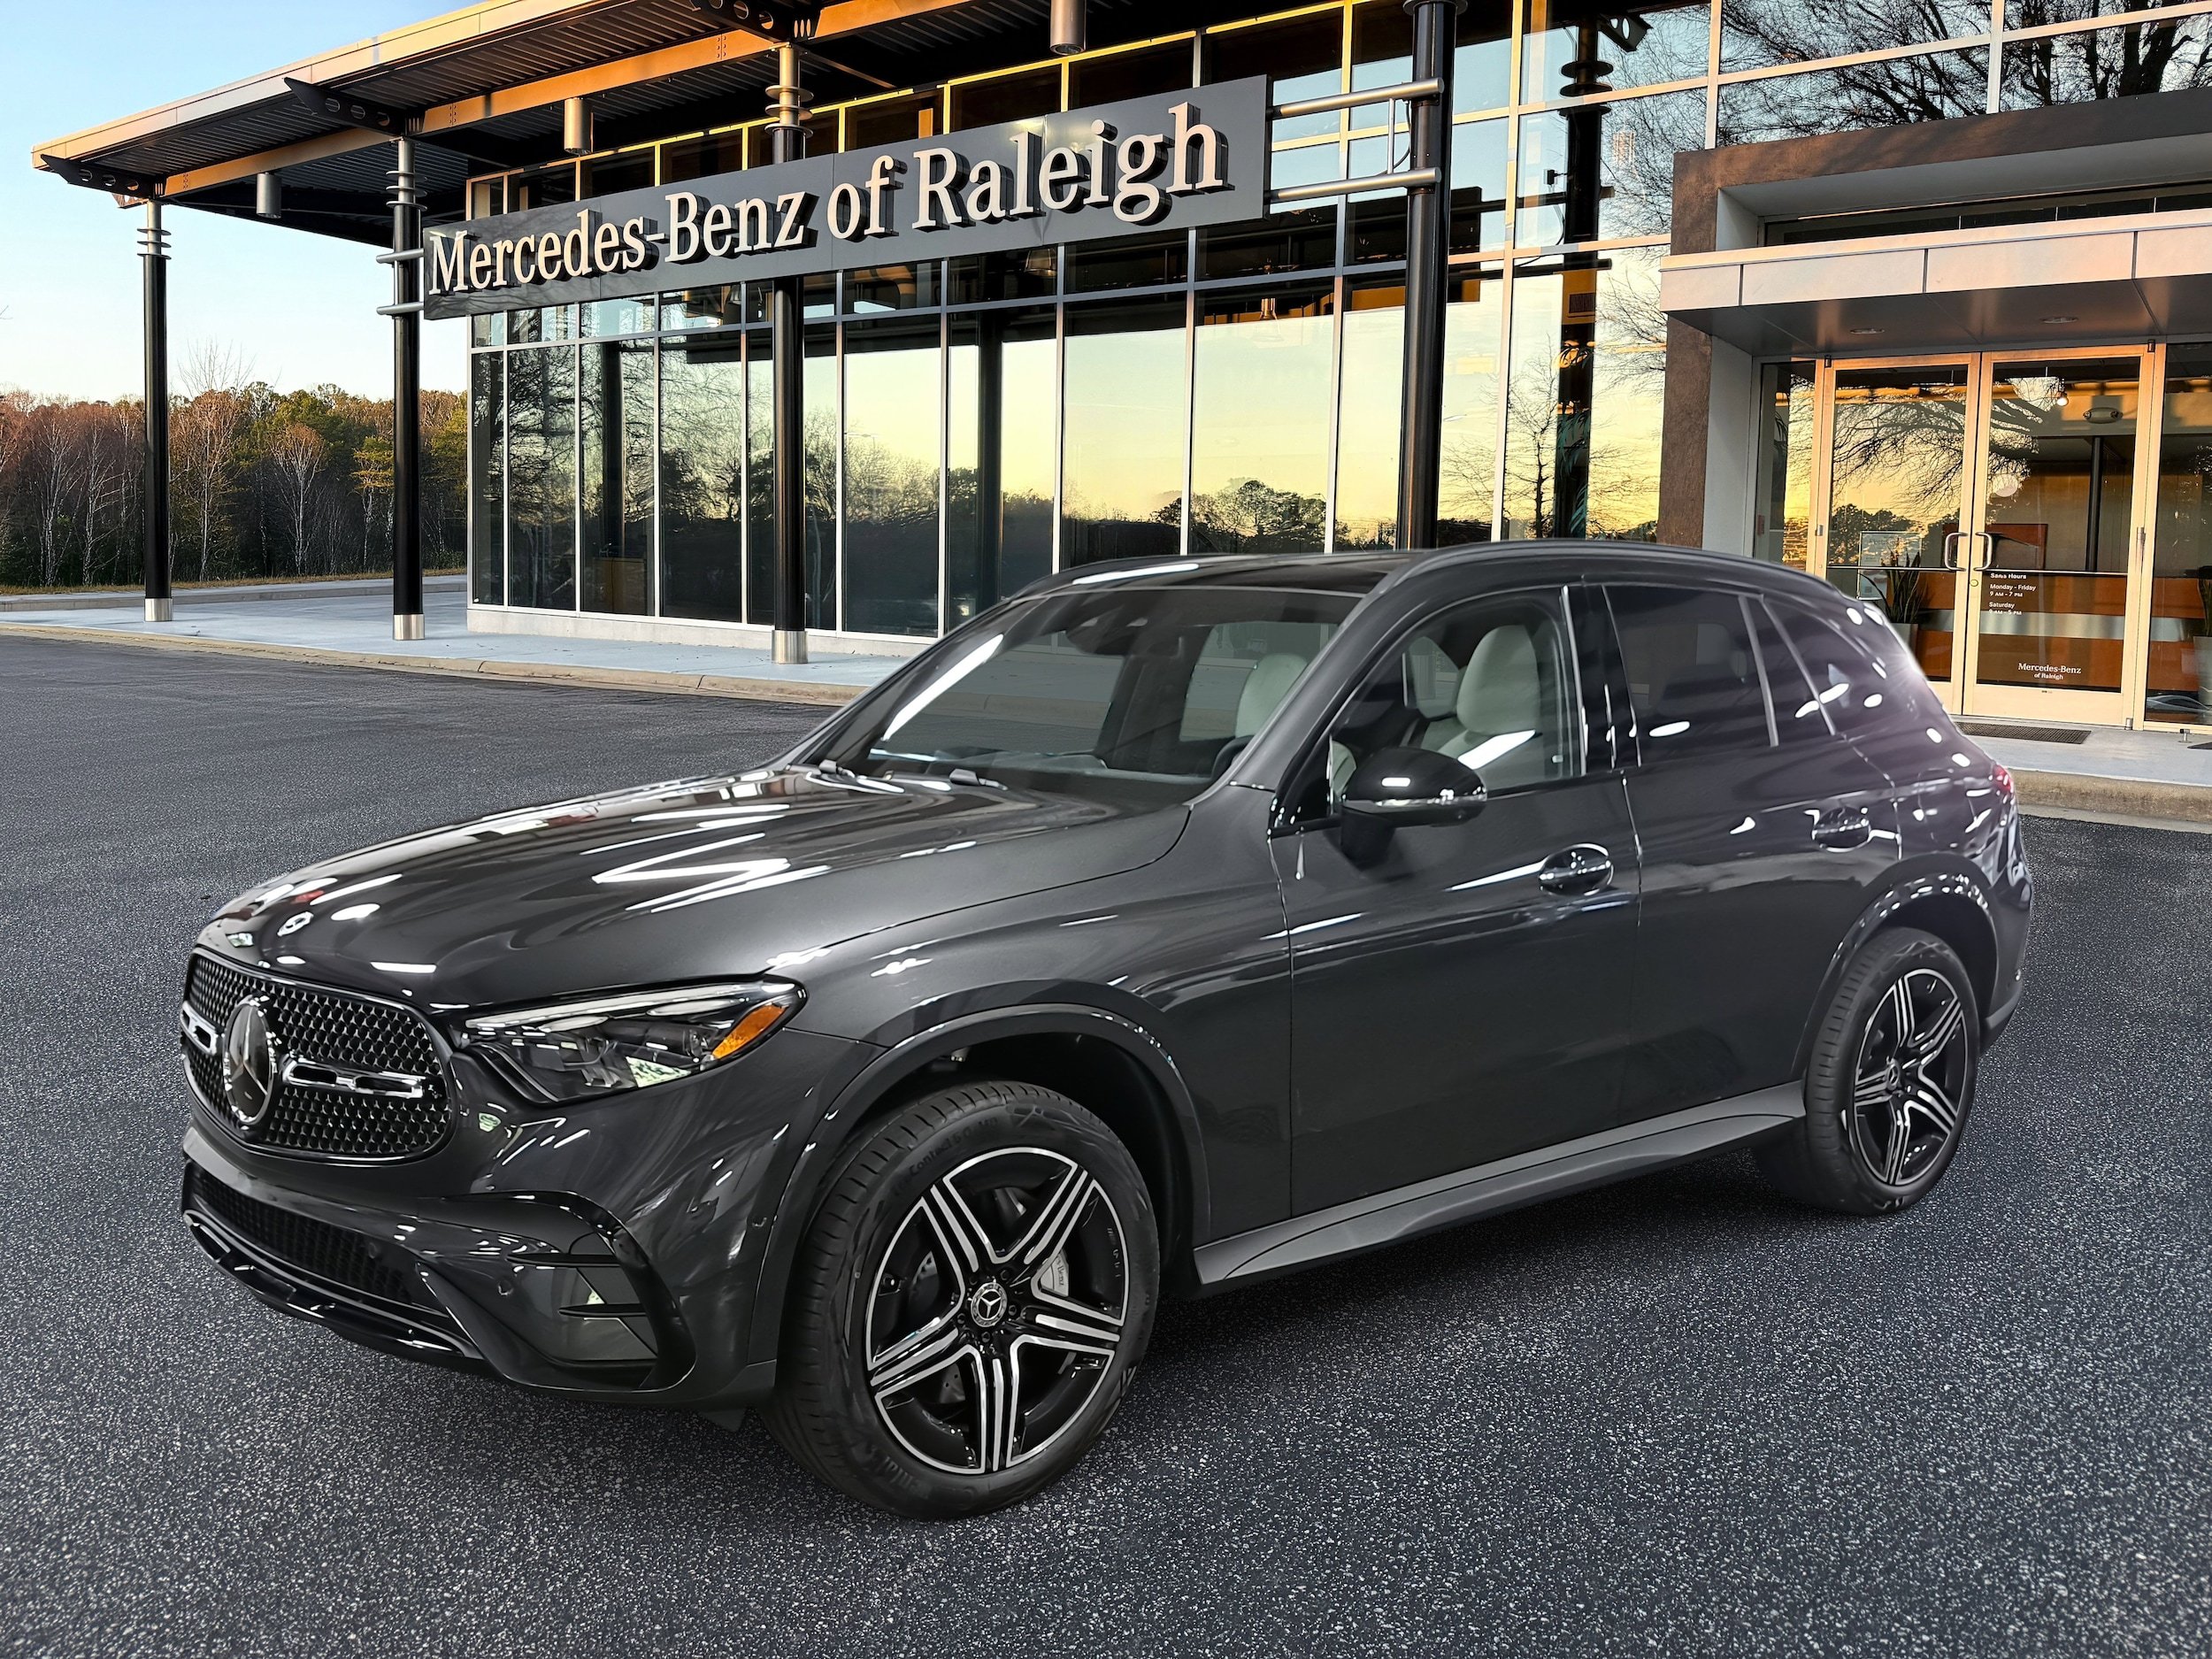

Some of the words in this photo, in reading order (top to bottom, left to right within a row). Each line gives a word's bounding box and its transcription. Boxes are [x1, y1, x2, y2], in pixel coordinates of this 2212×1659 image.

[428, 189, 806, 296] Mercedes-Benz
[828, 156, 897, 239] of
[913, 101, 1222, 223] Raleigh
[2018, 663, 2081, 674] Mercedes-Benz
